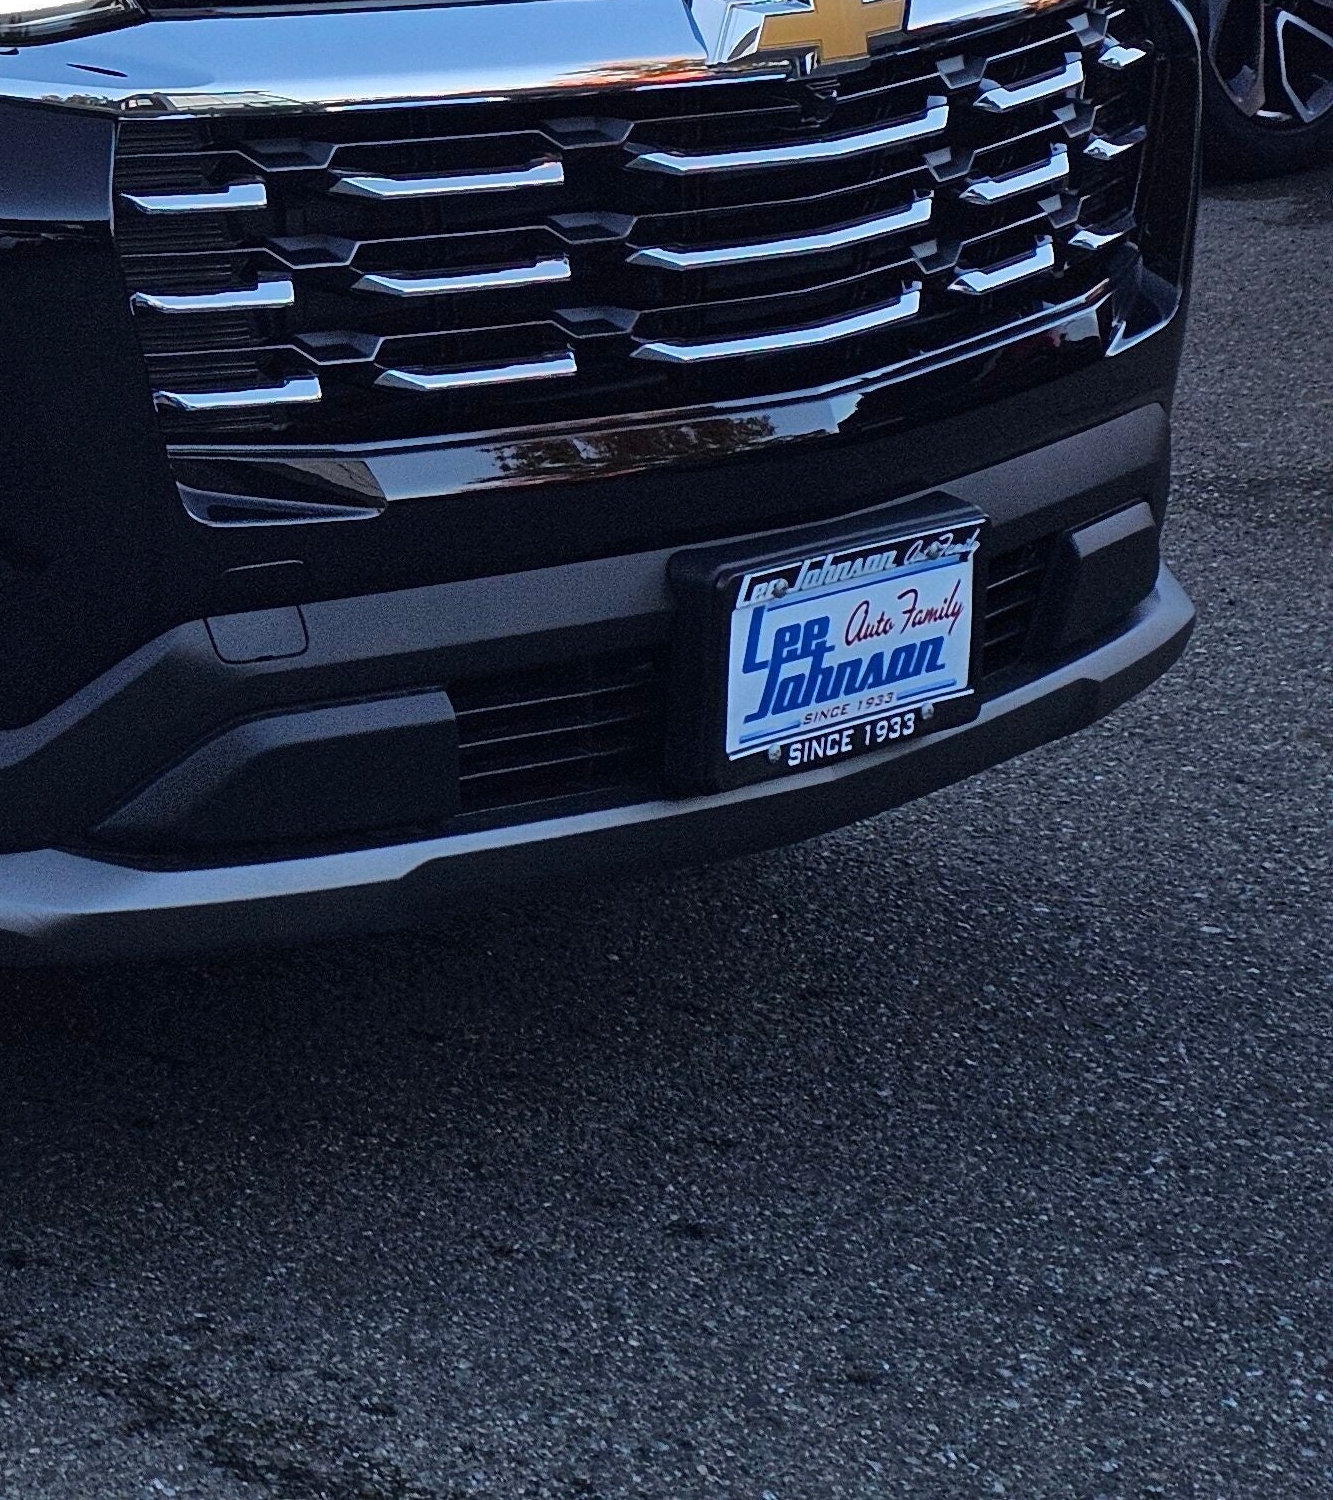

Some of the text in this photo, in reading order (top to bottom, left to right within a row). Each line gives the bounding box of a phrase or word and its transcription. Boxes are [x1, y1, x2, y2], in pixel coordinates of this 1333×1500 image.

[789, 553, 898, 597] Johnson
[742, 605, 833, 675] Lee
[844, 578, 965, 646] Auto Family
[743, 636, 947, 725] Johnson
[802, 691, 895, 726] SINCE 1933
[787, 712, 916, 767] SINCE 1933
